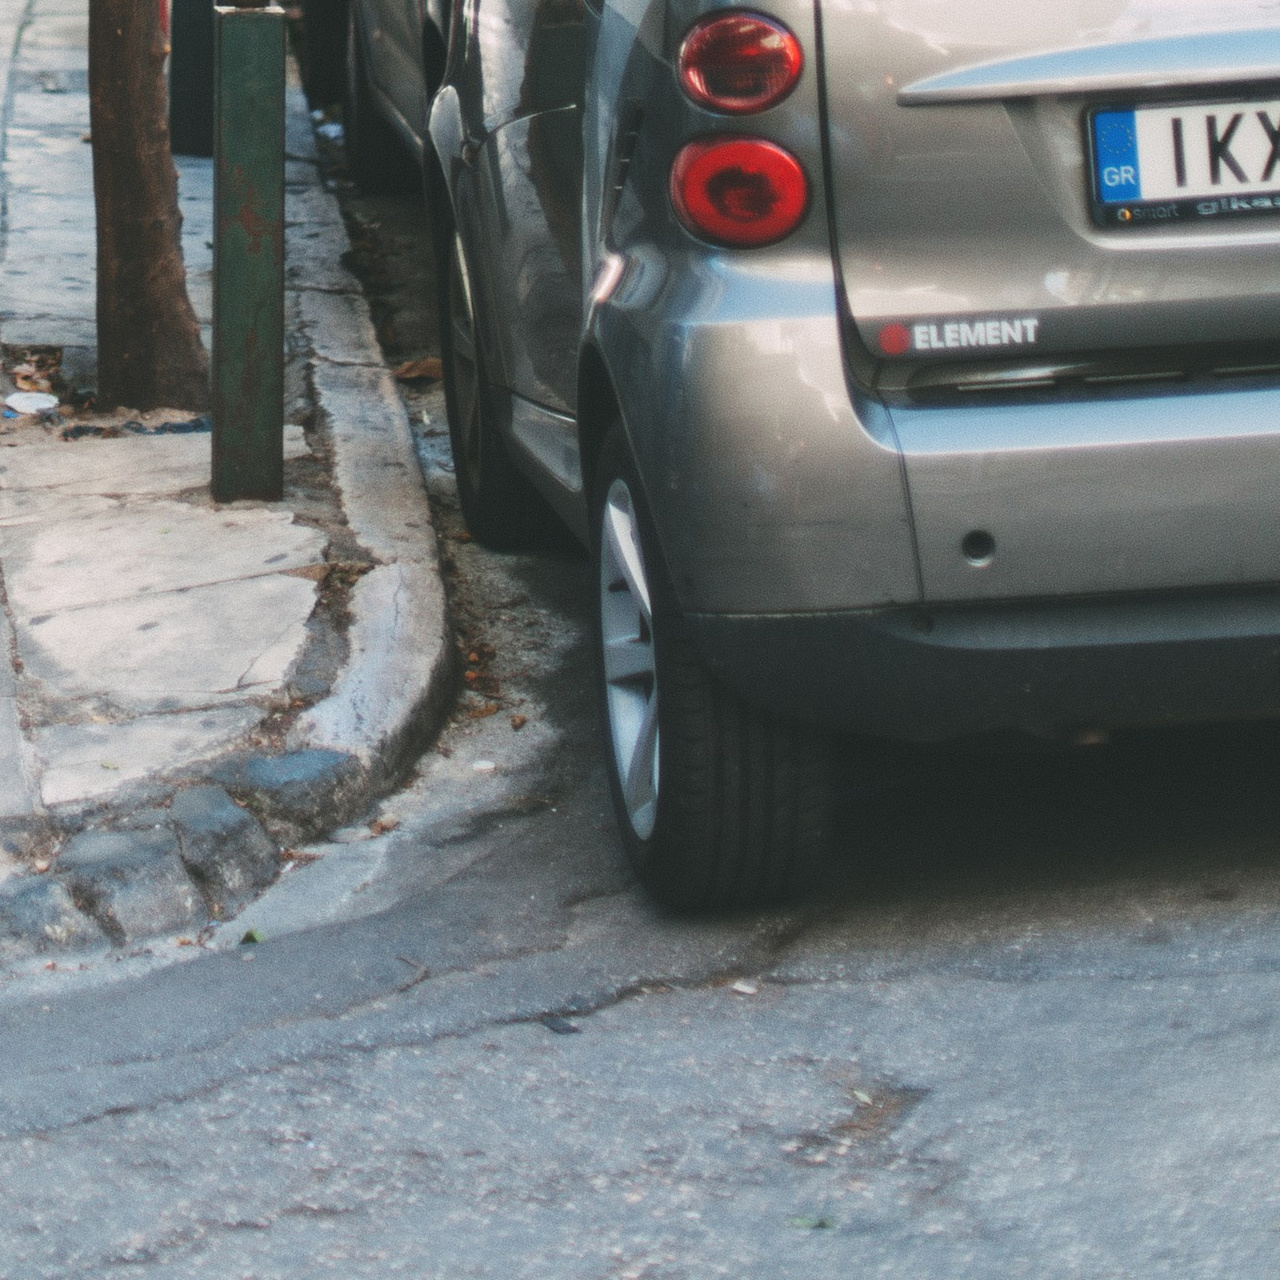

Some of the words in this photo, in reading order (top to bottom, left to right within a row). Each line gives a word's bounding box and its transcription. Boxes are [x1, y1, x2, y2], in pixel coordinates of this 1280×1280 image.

[1103, 165, 1137, 187] GR
[1133, 203, 1180, 220] smart
[914, 317, 1038, 349] ELEMENT
